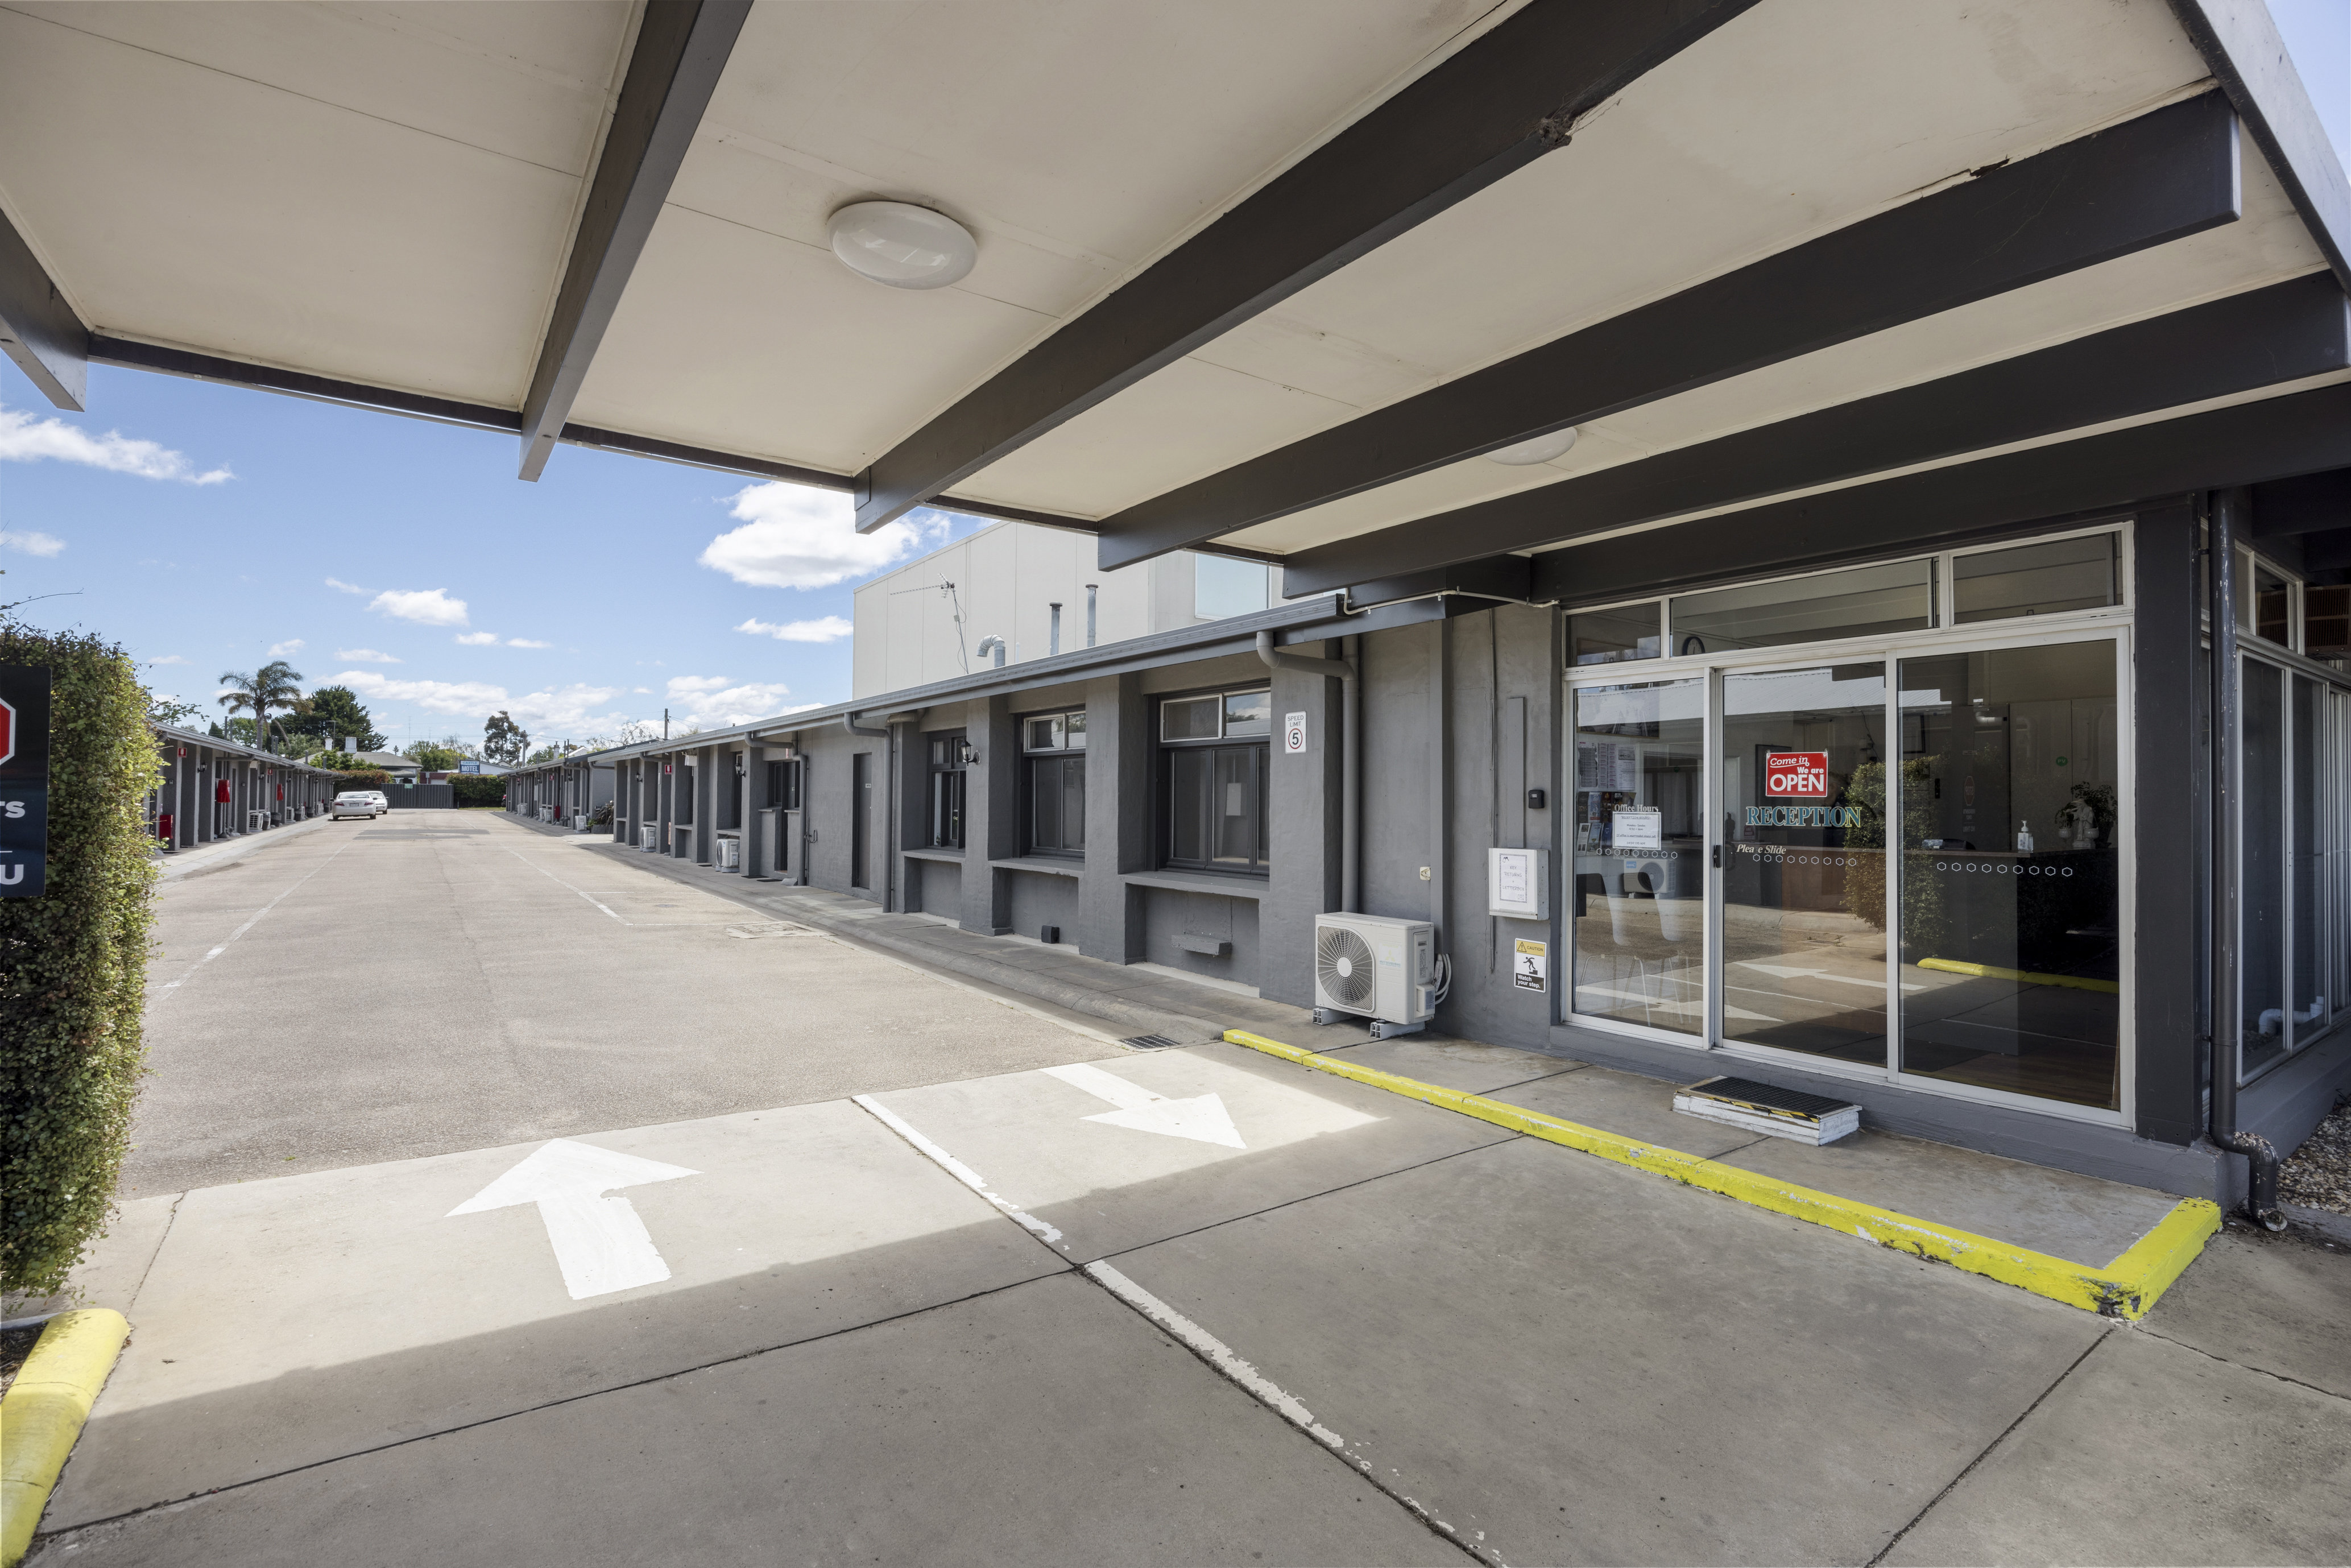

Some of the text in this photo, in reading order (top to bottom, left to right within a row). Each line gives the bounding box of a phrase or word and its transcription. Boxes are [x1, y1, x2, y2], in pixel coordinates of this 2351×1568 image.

[1292, 733, 1299, 745] 5
[1799, 756, 1810, 766] in
[1770, 774, 1824, 791] OPEN
[1746, 806, 1862, 828] RECEPTION
[1737, 844, 1786, 854] Pleae Slide
